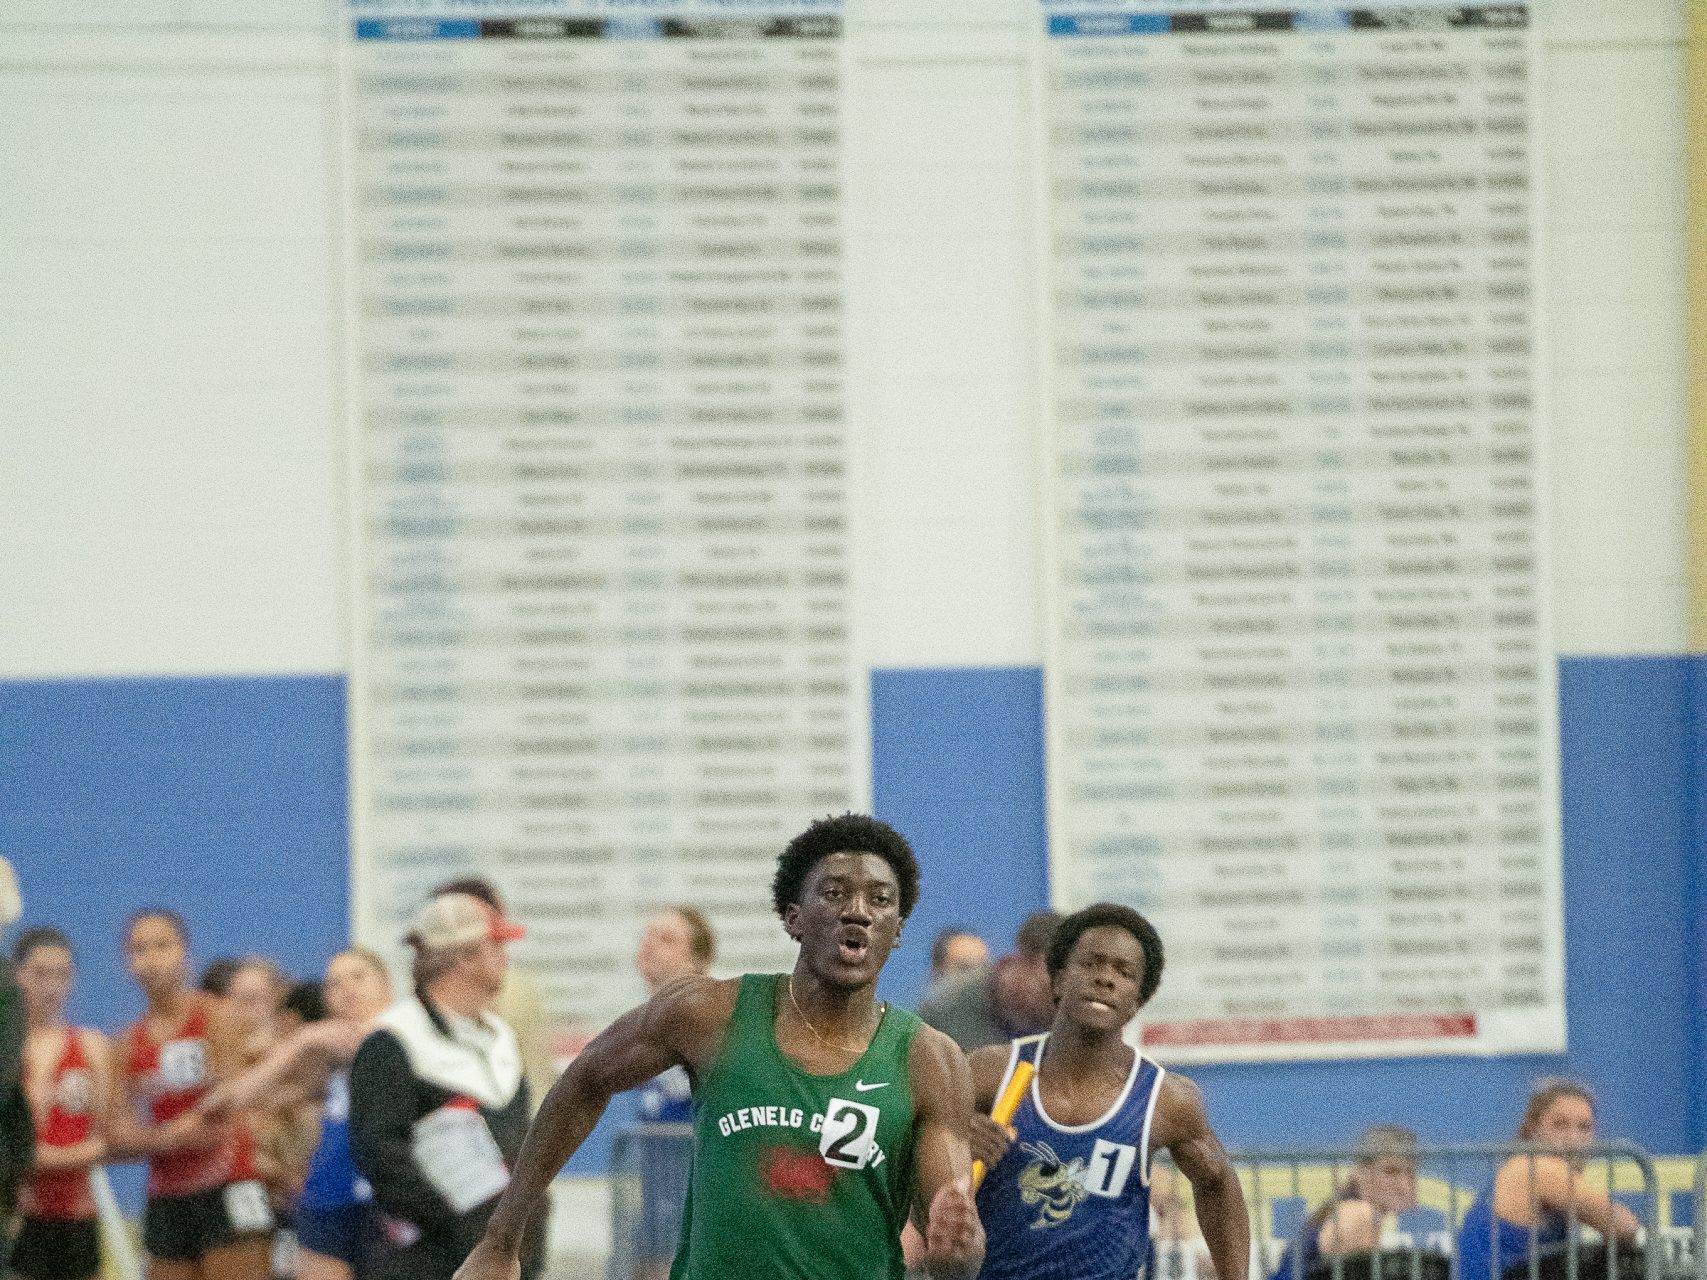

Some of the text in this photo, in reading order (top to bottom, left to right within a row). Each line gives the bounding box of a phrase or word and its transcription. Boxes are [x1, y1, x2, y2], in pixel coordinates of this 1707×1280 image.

[718, 1106, 803, 1137] GLENELG
[825, 1106, 868, 1163] 2
[1100, 1148, 1122, 1192] 1
